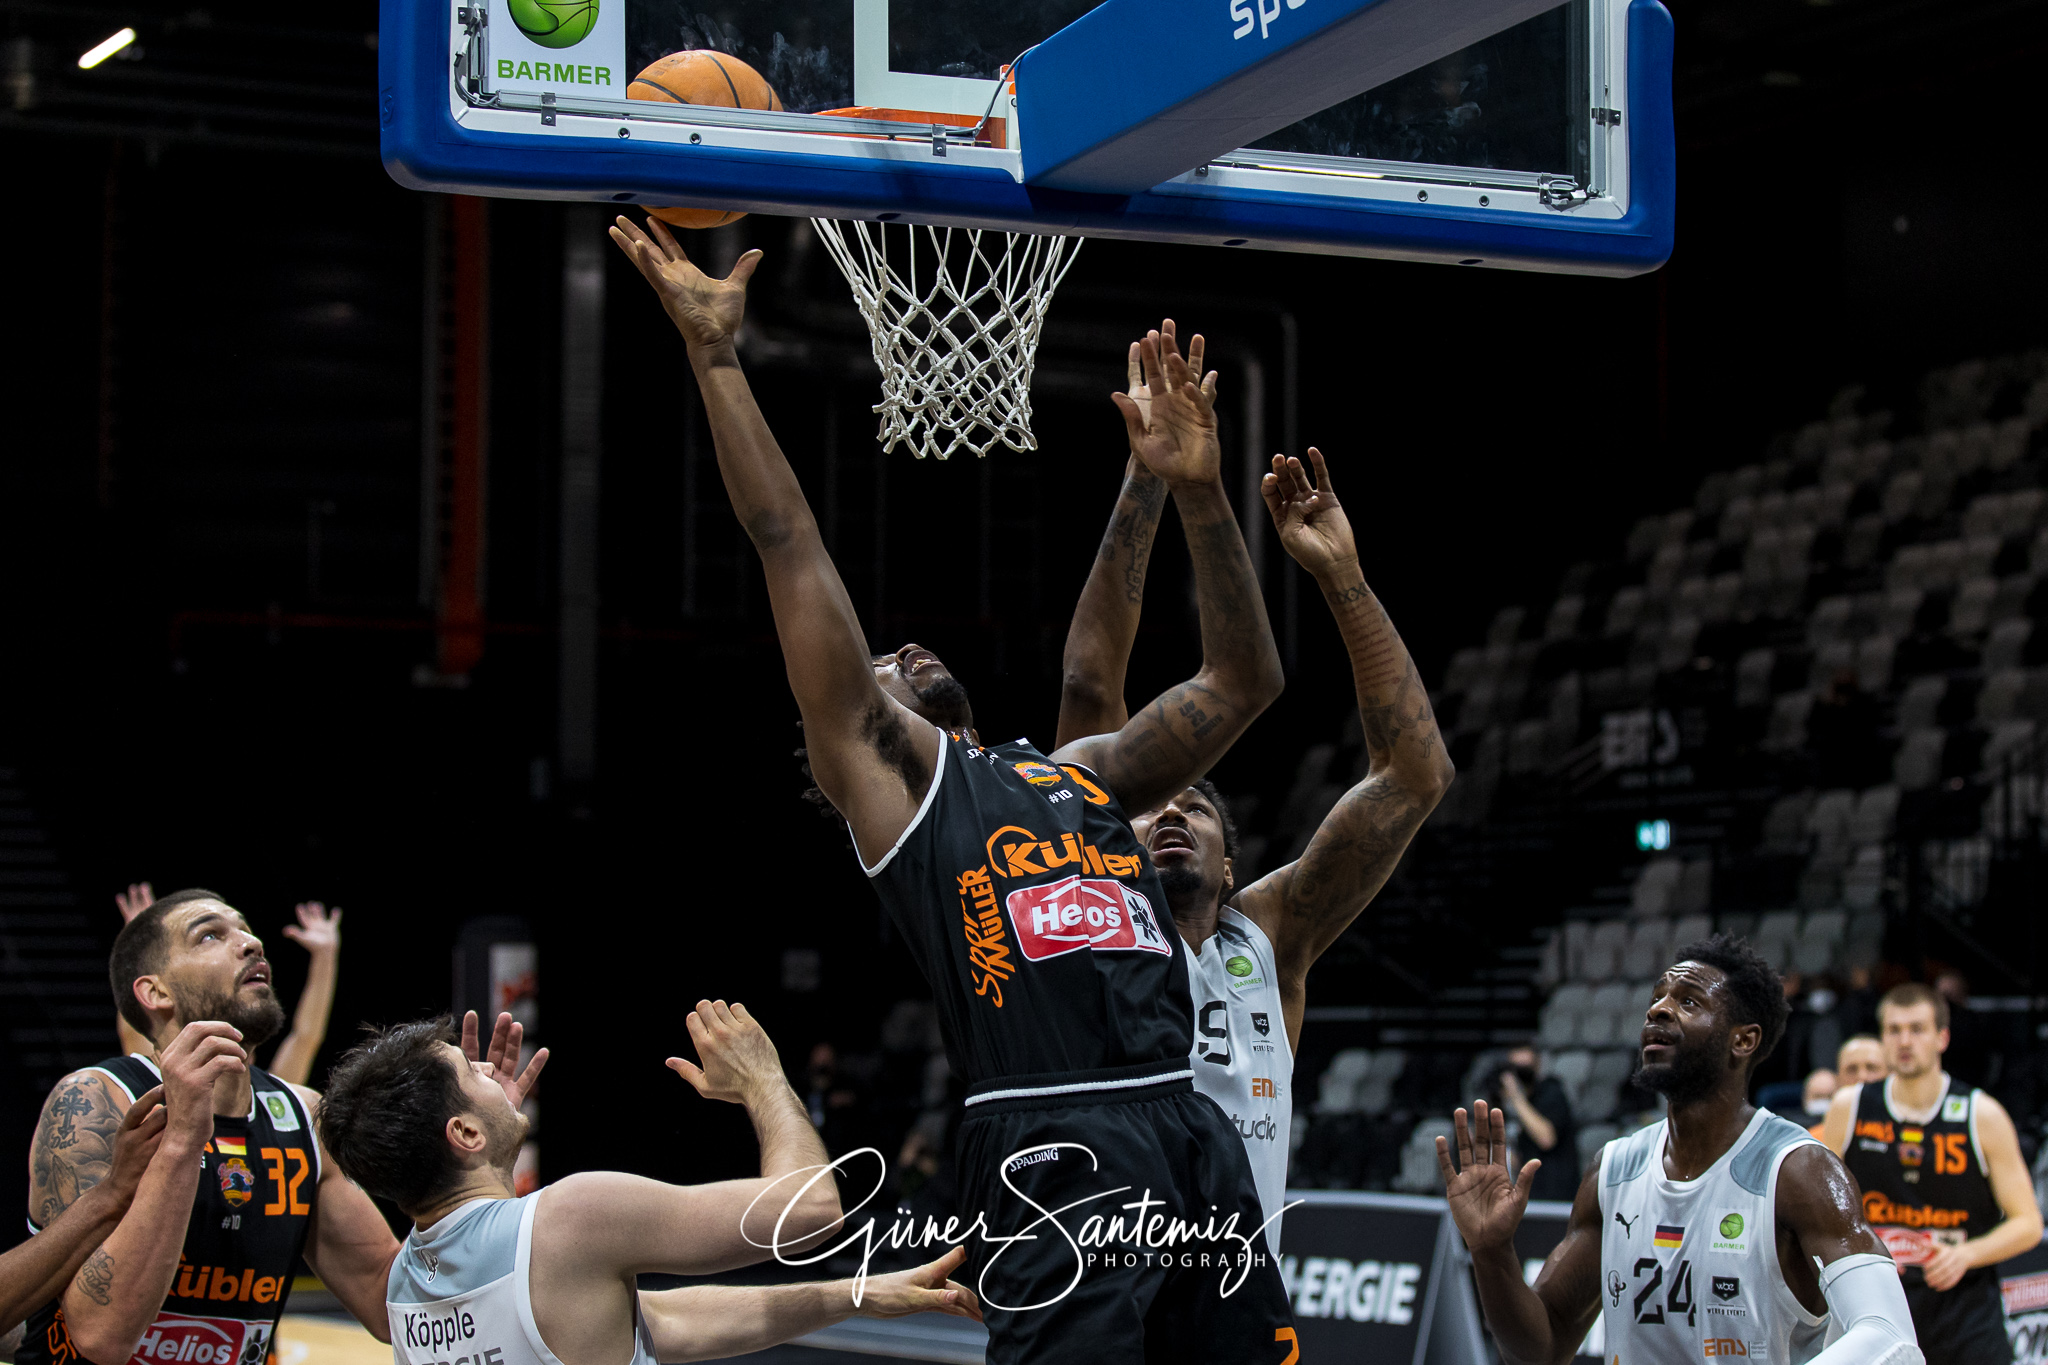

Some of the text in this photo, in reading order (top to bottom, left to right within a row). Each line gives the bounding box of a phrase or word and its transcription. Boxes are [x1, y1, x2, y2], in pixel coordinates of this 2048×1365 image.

[1230, 0, 1307, 40] sp
[497, 59, 612, 87] BARMER
[1049, 789, 1073, 804] #10
[1002, 832, 1142, 878] Küler
[1233, 978, 1263, 989] BARMER
[1231, 1113, 1276, 1141] tudio
[1009, 1147, 1059, 1172] SPALDING
[1931, 1132, 1968, 1176] 15
[260, 1147, 311, 1216] 32
[221, 1214, 242, 1231] #10
[1713, 1242, 1745, 1250] BARMER
[169, 1265, 286, 1304] übler
[1633, 1257, 1697, 1328] 24
[133, 1330, 234, 1365] Helios
[405, 1307, 476, 1353] Köpple
